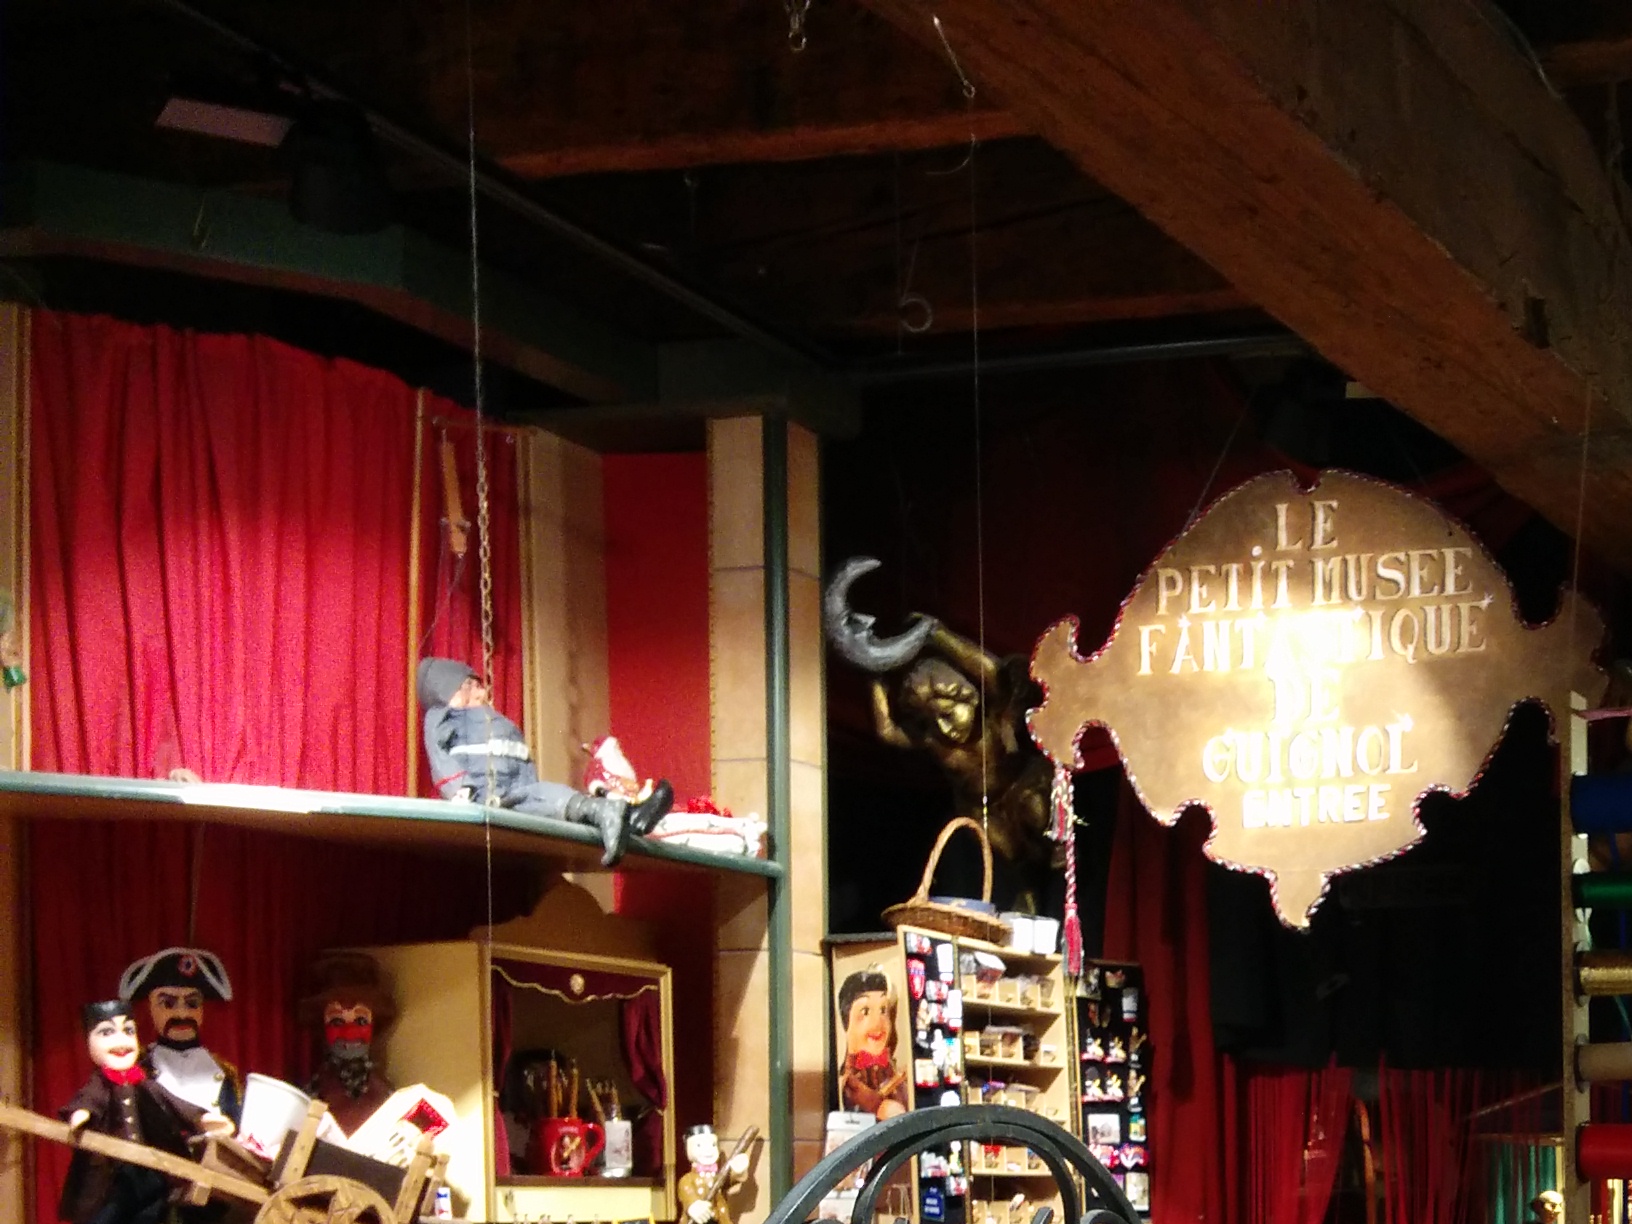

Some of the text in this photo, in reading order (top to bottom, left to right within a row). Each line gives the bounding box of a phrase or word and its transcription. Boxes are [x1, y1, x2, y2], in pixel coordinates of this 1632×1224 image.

[1276, 501, 1339, 552] LE
[1156, 547, 1476, 616] PETIT MUSEE
[1137, 600, 1491, 676] FANTATIQUE
[1270, 669, 1342, 721] DE
[1202, 722, 1418, 784] GUIGNOL
[1243, 784, 1391, 830] ENTREE
